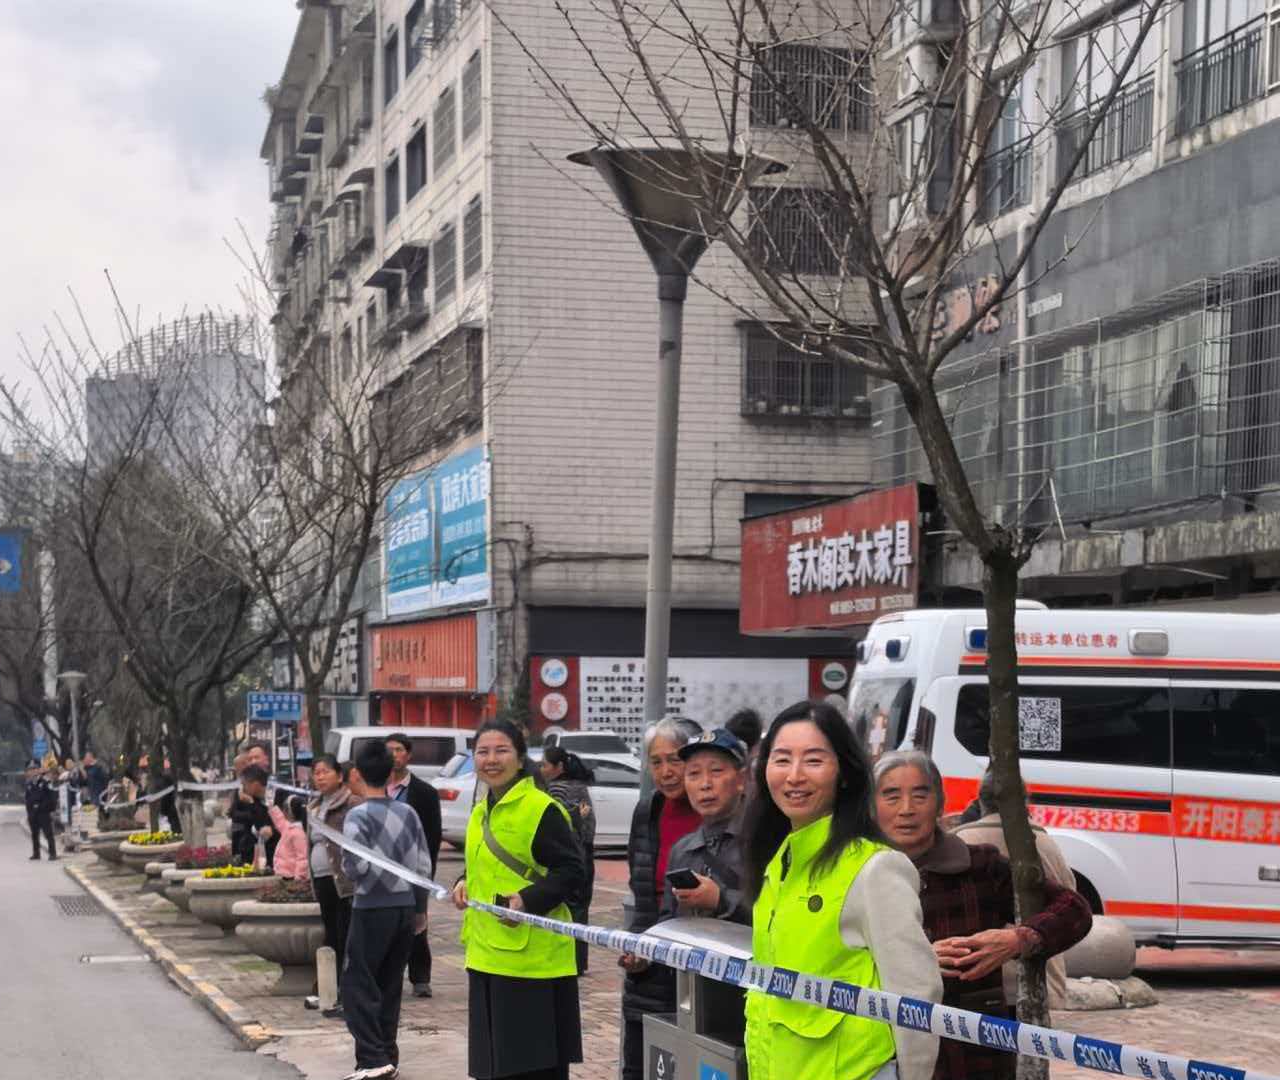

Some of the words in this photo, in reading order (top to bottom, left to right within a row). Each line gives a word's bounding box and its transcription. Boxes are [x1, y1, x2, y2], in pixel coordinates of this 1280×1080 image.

[787, 520, 912, 595] 香木阁实木家具
